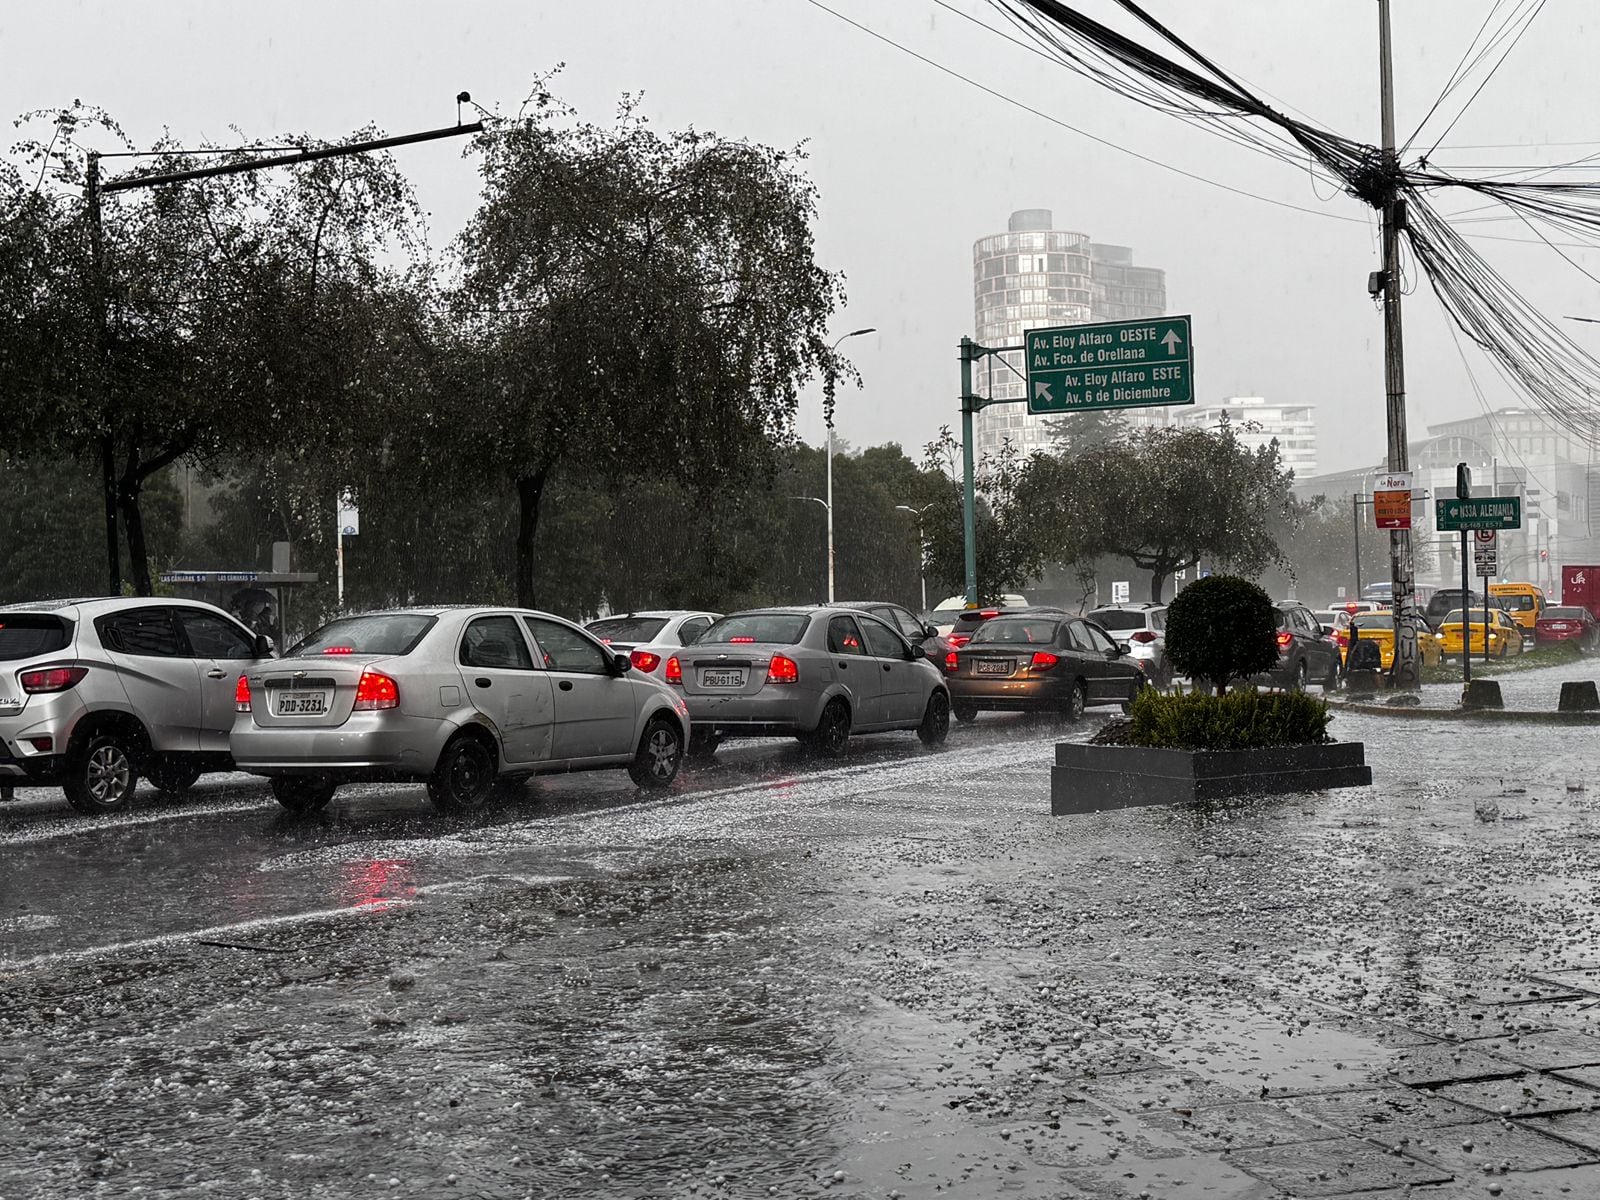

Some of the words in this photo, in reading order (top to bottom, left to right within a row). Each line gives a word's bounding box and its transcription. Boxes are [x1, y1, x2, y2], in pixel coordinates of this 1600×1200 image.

[1033, 338, 1049, 349] Av.
[1053, 335, 1075, 349] Eloy
[1079, 333, 1112, 346] Alfaro
[1120, 328, 1156, 342] OESTE
[1034, 354, 1050, 366] Av.
[1053, 353, 1077, 365] Fco.
[1081, 351, 1094, 362] de
[1097, 348, 1145, 361] Orellana
[1065, 375, 1081, 387] Av.
[1084, 373, 1107, 387] Eloy
[1111, 371, 1145, 383] Alfaro
[1152, 367, 1181, 380] ESTE
[1065, 392, 1082, 404] Av.
[1085, 390, 1092, 402] 6
[1096, 389, 1110, 401] de
[1113, 385, 1171, 400] Diciembre
[1387, 476, 1405, 488] Ñora
[1480, 503, 1514, 517] ALEMANIA
[705, 675, 740, 685] PBU-6115
[279, 699, 322, 712] PDD-3231
